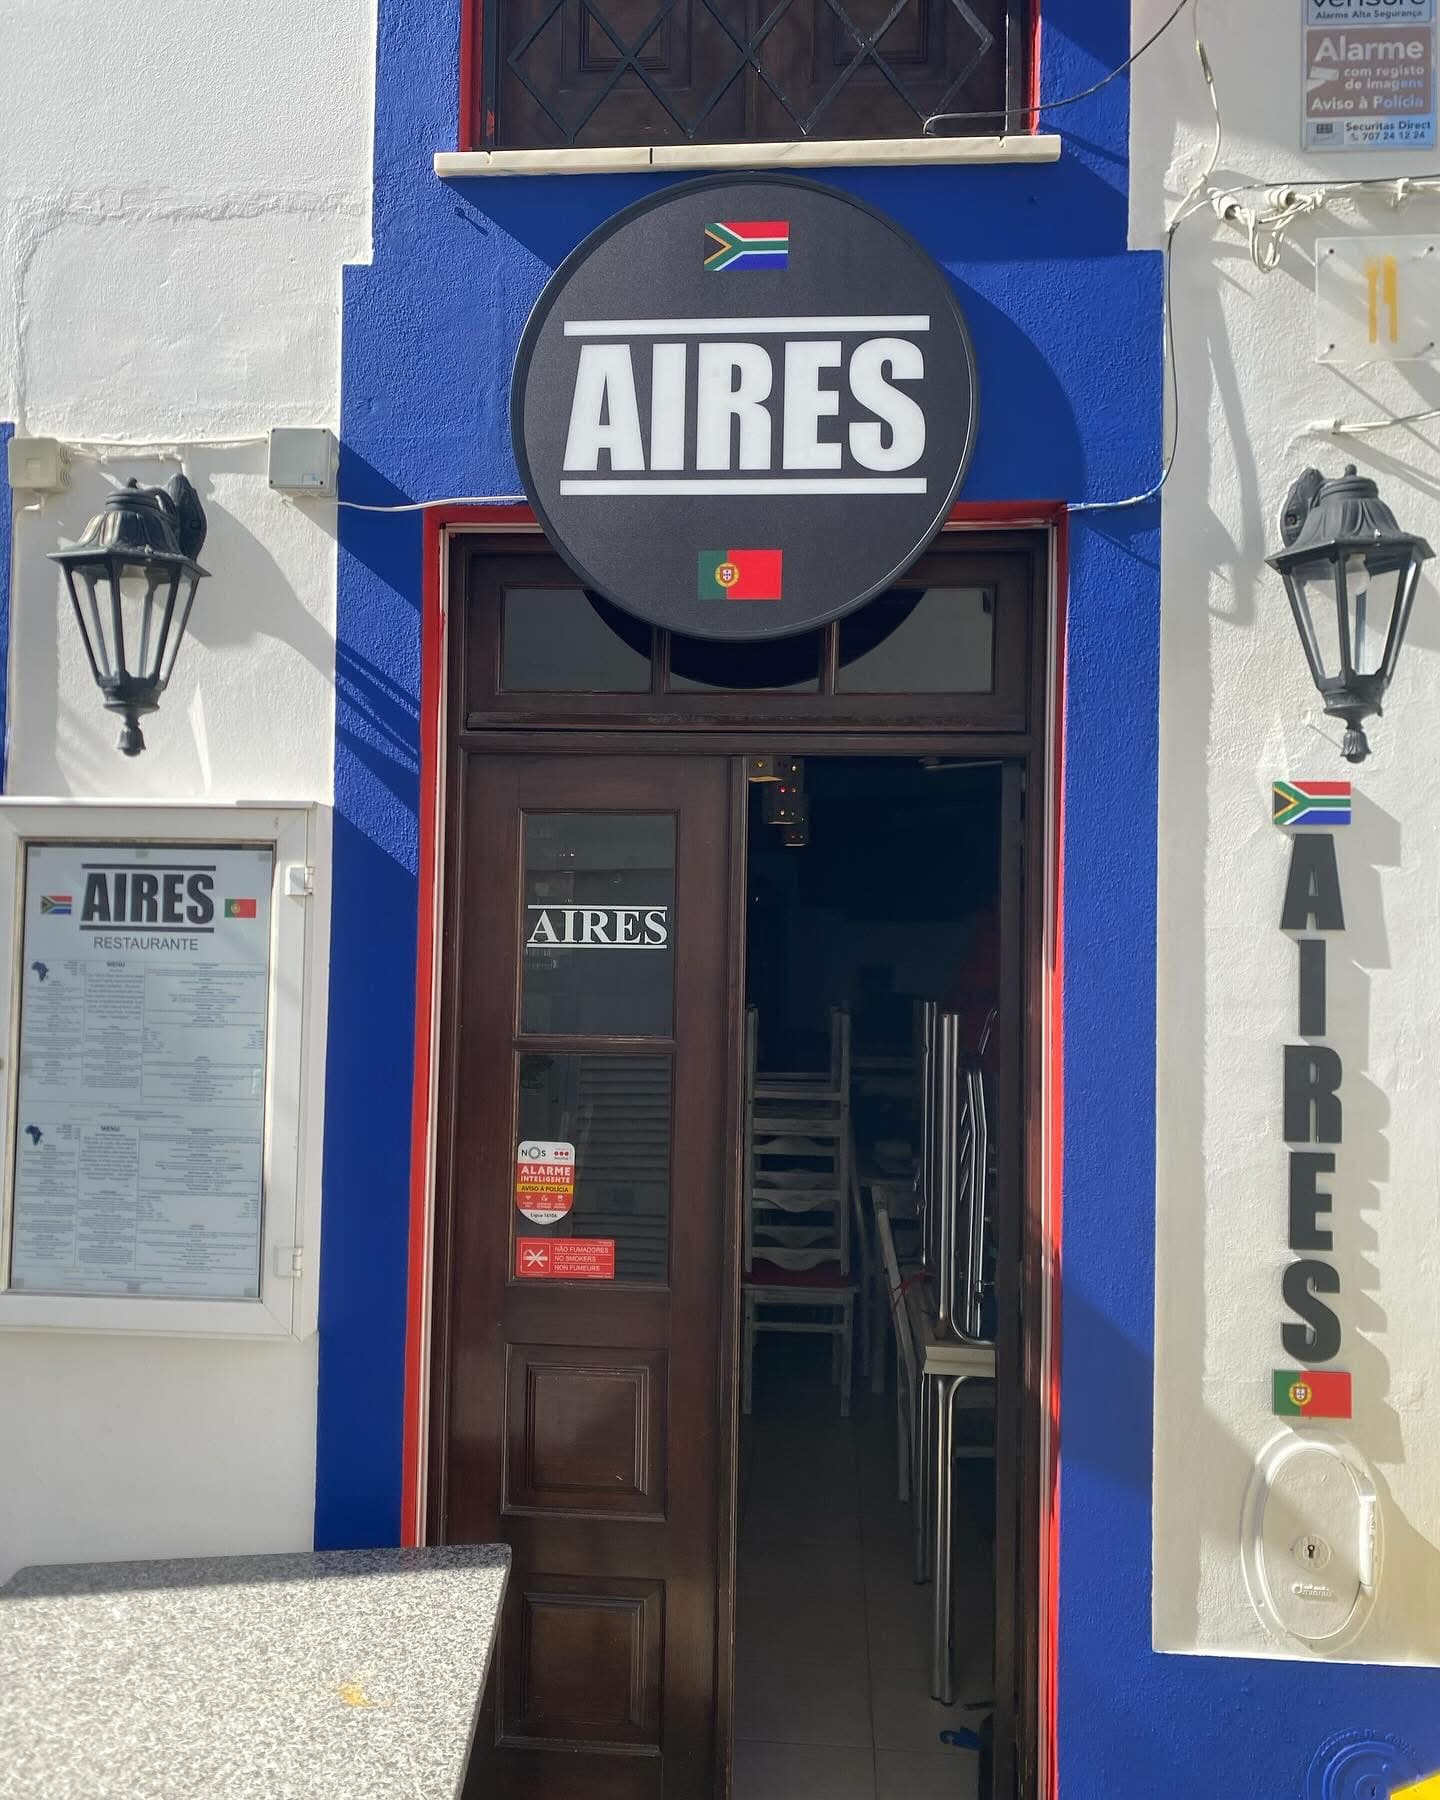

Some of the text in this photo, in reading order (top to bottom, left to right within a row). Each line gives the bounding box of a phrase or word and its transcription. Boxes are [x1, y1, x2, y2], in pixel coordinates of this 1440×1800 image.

[1315, 9, 1423, 20] Alarme Alta Segurança
[1314, 35, 1425, 62] Alarme
[1343, 65, 1425, 79] com registo
[1344, 78, 1362, 89] de
[1311, 93, 1425, 111] Aviso à Polícia
[1345, 120, 1431, 132] Securitas Direct
[1363, 132, 1381, 141] 707
[1383, 131, 1396, 140] 24
[1413, 130, 1426, 139] 24
[562, 337, 926, 472] AIRES
[80, 872, 215, 925] AIRES
[527, 909, 668, 945] AIRES
[93, 936, 199, 951] RESTAURANTE
[1279, 833, 1346, 1364] AIRES
[520, 1146, 546, 1160] NOS
[520, 1165, 571, 1176] ALARME
[520, 1175, 571, 1184] INTELIGENTE
[554, 1245, 609, 1254] NÃO FUMADORES
